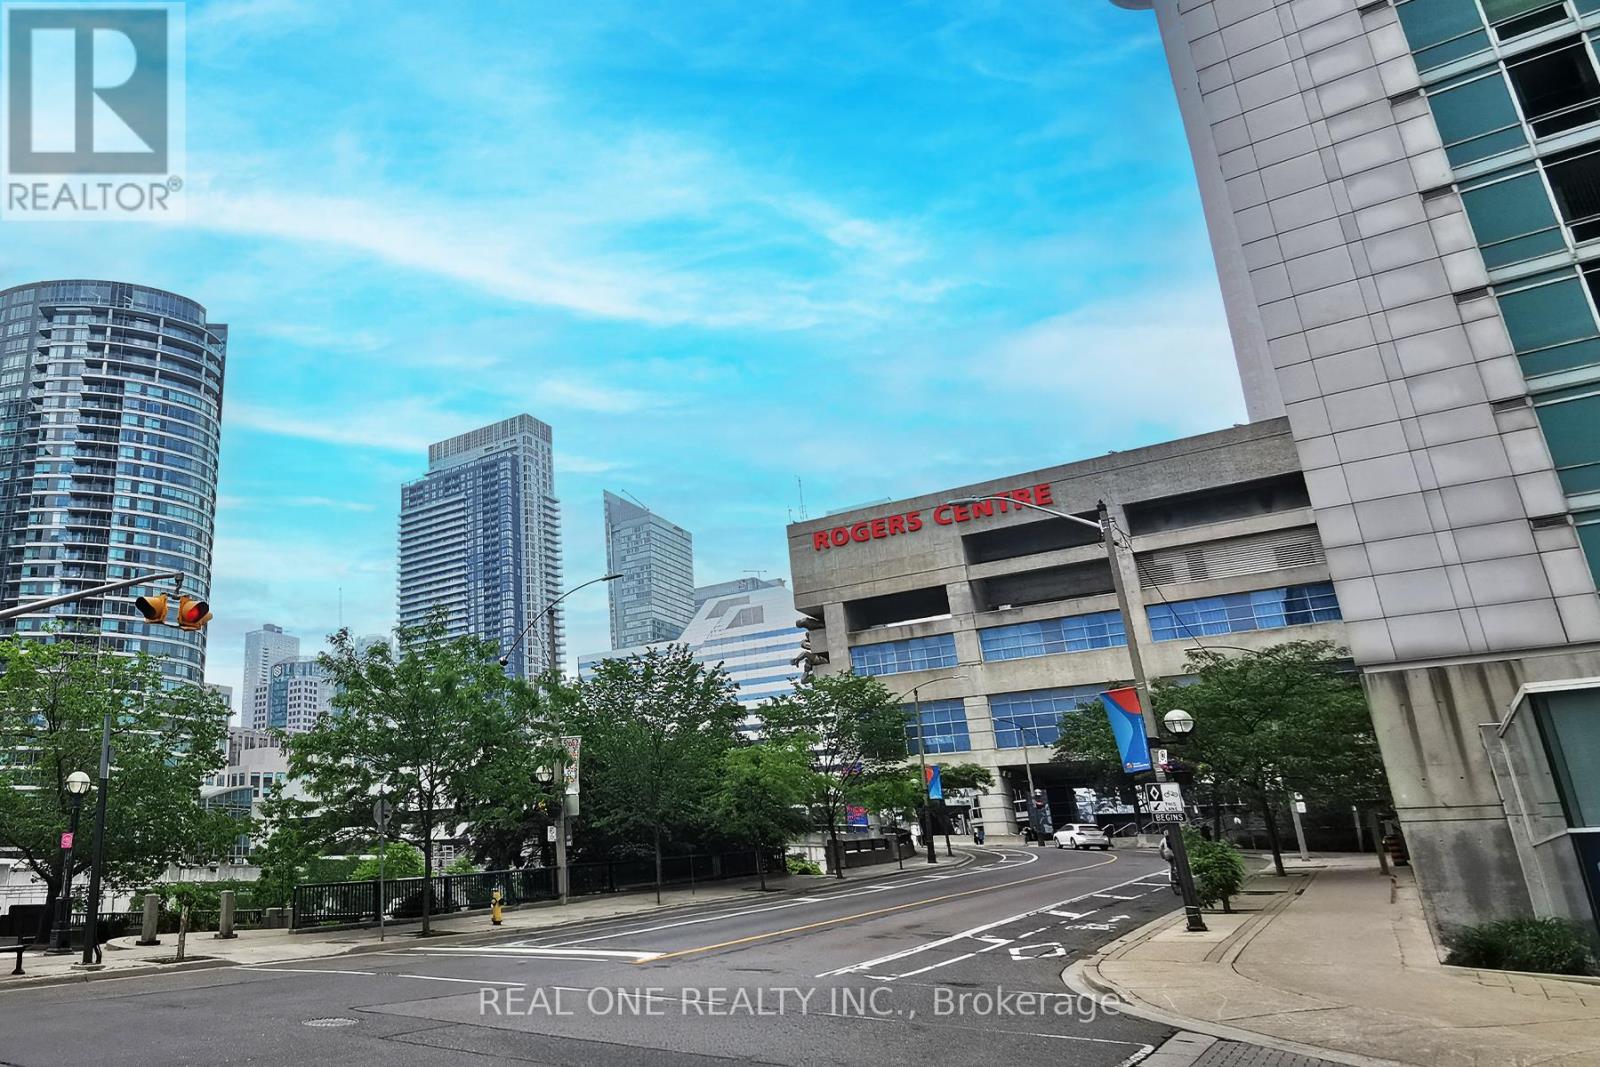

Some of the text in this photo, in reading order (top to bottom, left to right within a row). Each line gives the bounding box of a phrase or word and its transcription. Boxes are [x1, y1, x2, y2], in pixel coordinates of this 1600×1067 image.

[813, 483, 1054, 550] ROGERS CENTRE
[1155, 813, 1184, 822] BEGINS
